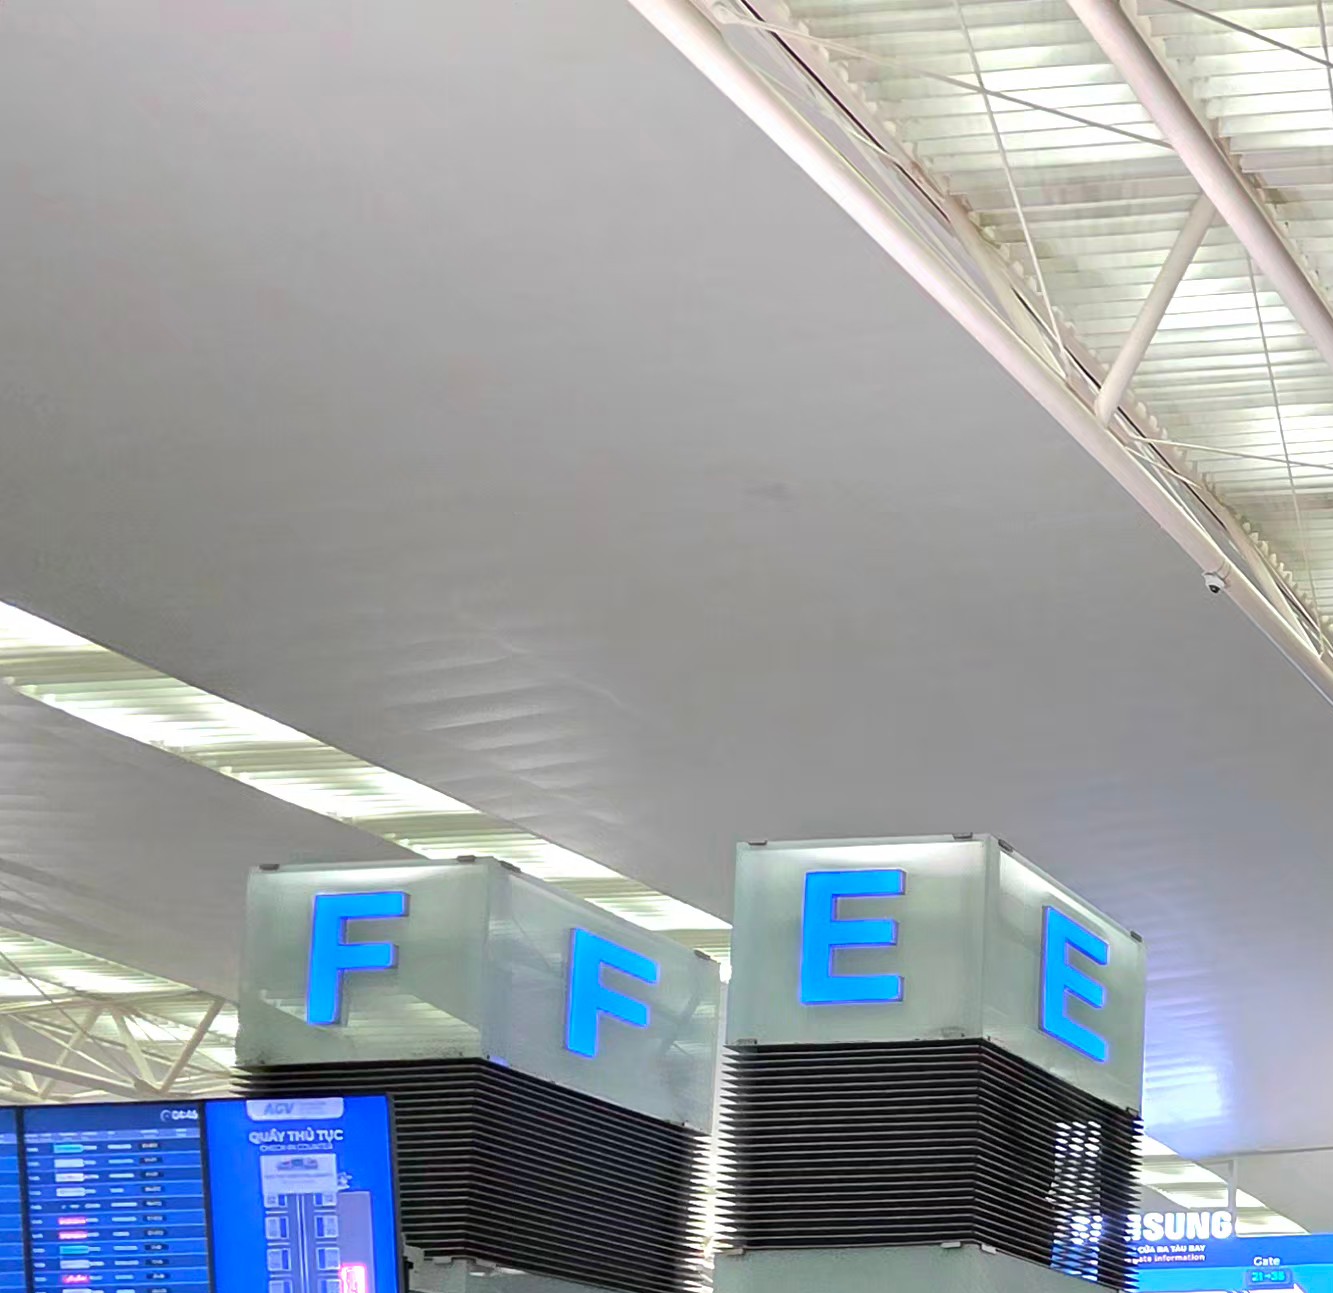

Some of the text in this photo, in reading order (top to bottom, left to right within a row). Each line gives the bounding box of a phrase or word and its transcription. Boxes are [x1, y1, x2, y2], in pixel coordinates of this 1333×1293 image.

[306, 890, 409, 1026] F
[566, 927, 660, 1058] F
[800, 868, 906, 1006] E
[1040, 905, 1110, 1063] E
[1126, 1211, 1232, 1241] SUNG
[1154, 1253, 1206, 1263] information
[1253, 1256, 1281, 1266] Gate
